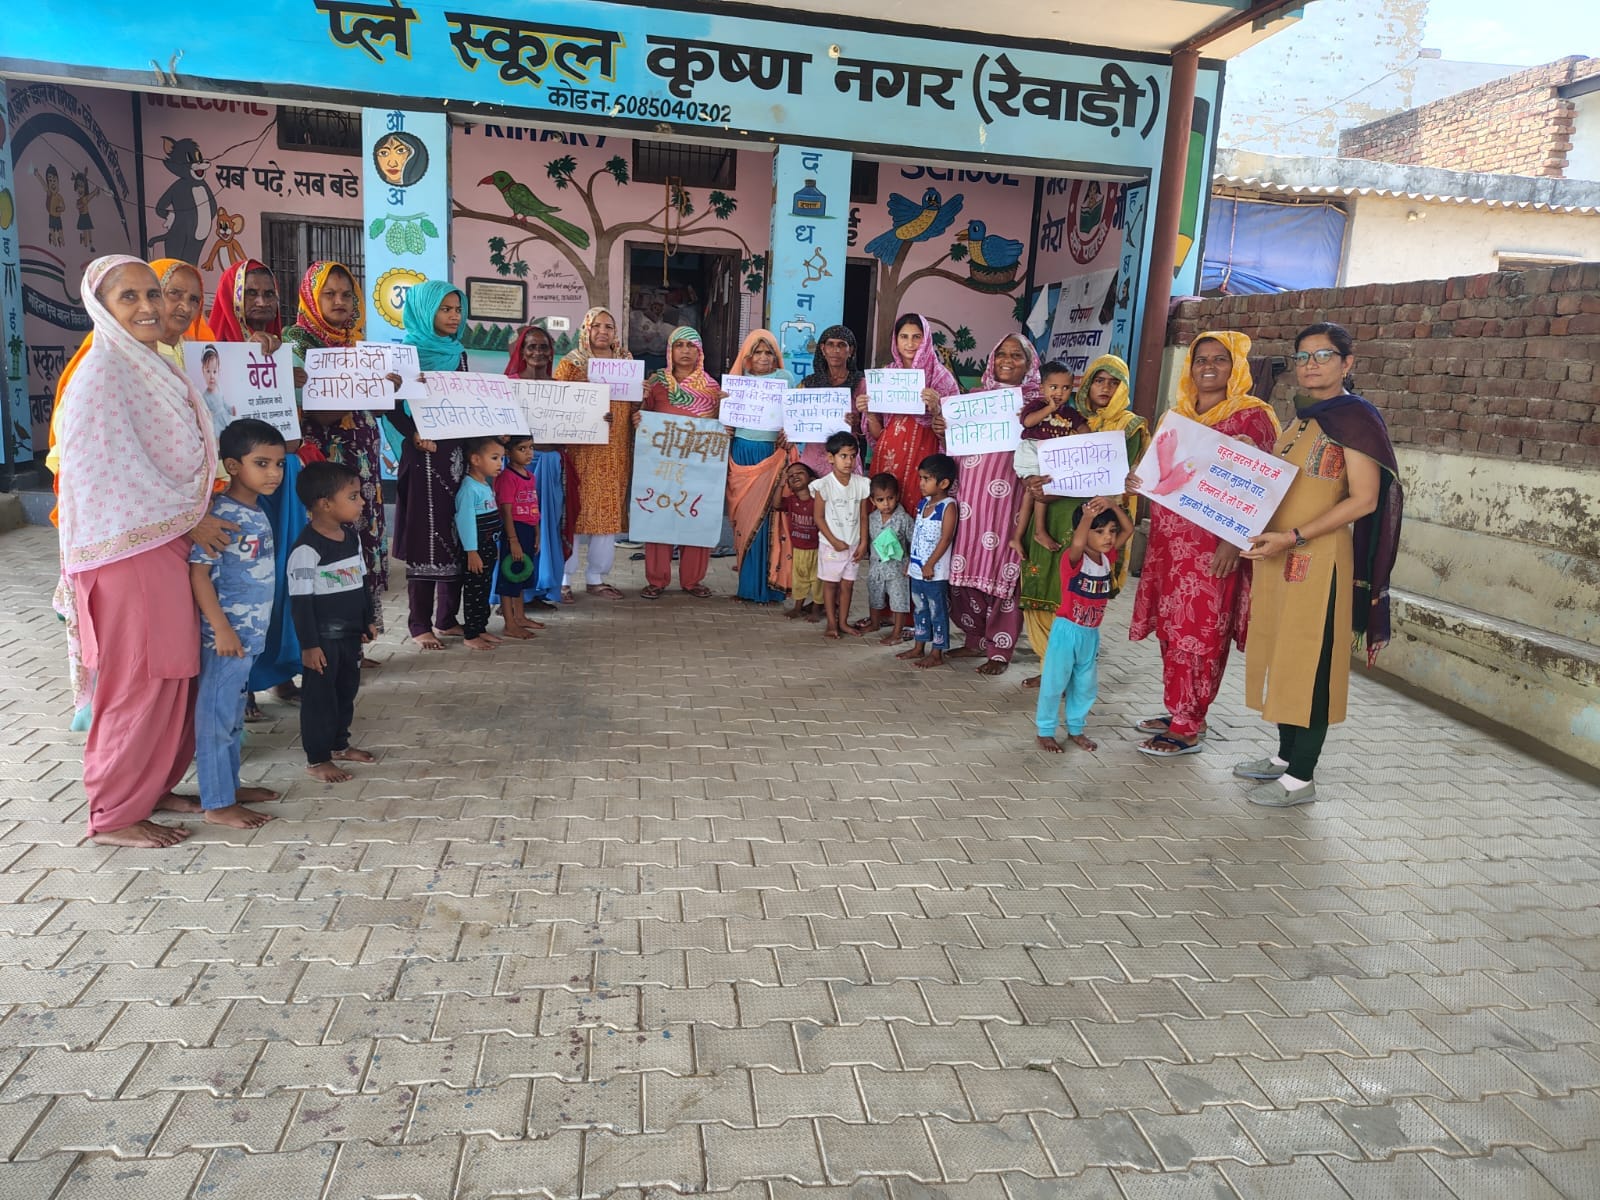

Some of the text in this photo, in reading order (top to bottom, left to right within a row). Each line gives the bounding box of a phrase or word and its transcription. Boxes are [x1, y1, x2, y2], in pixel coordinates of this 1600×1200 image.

[316, 0, 421, 63] प्ले
[444, 11, 626, 88] स्कूल
[646, 35, 812, 98] कृष्ण
[834, 56, 963, 110] नगर
[612, 92, 731, 123] 6085040302
[386, 110, 405, 132] औ
[801, 151, 823, 174] द
[216, 165, 248, 190] सब
[294, 171, 326, 197] सब
[795, 225, 816, 244] ध
[797, 293, 815, 311] न
[247, 352, 277, 389] बेटी
[591, 361, 637, 377] MMMSY
[792, 361, 811, 379] प
